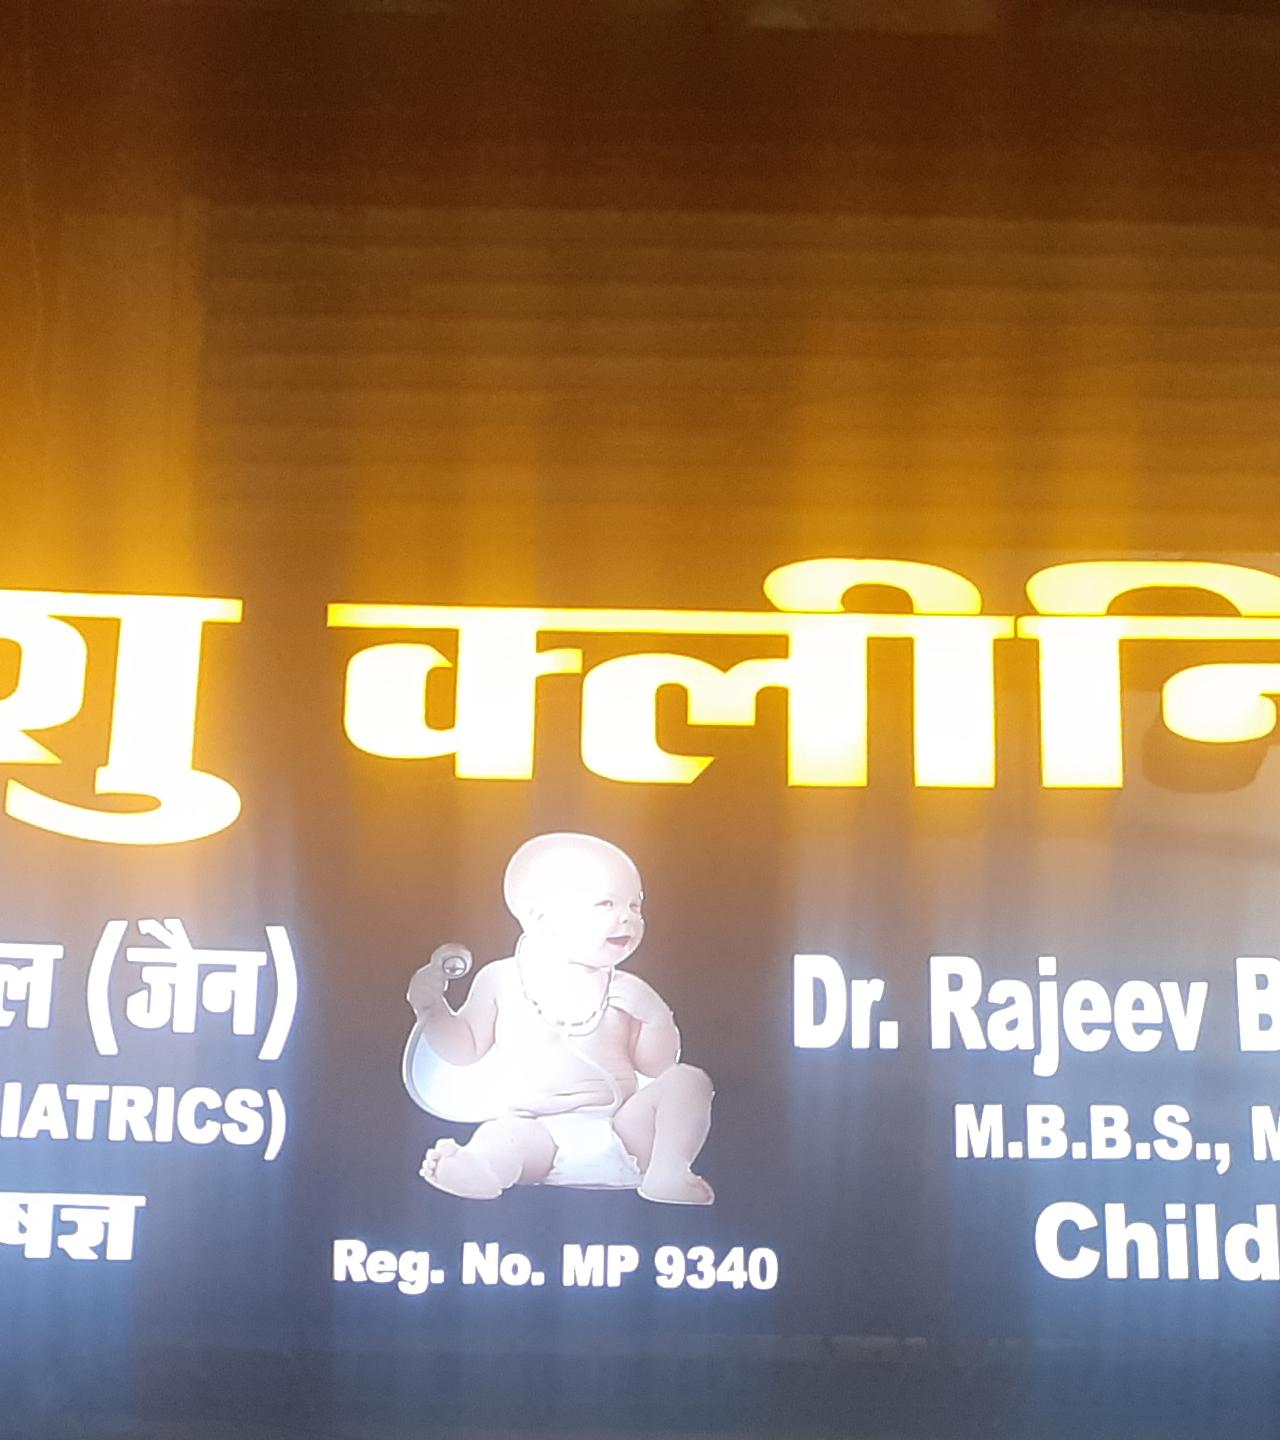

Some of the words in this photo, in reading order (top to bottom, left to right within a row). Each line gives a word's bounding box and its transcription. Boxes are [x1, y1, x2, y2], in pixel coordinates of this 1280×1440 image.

[85, 917, 299, 1061] (जैन)
[792, 953, 899, 1050] Dr.
[928, 954, 1210, 1078] Rajeev
[953, 1102, 1232, 1176] M.B.B.S.,
[332, 1238, 446, 1296] Reg.
[461, 1240, 546, 1287] No.
[561, 1242, 640, 1289] MP
[653, 1244, 780, 1291] 9340
